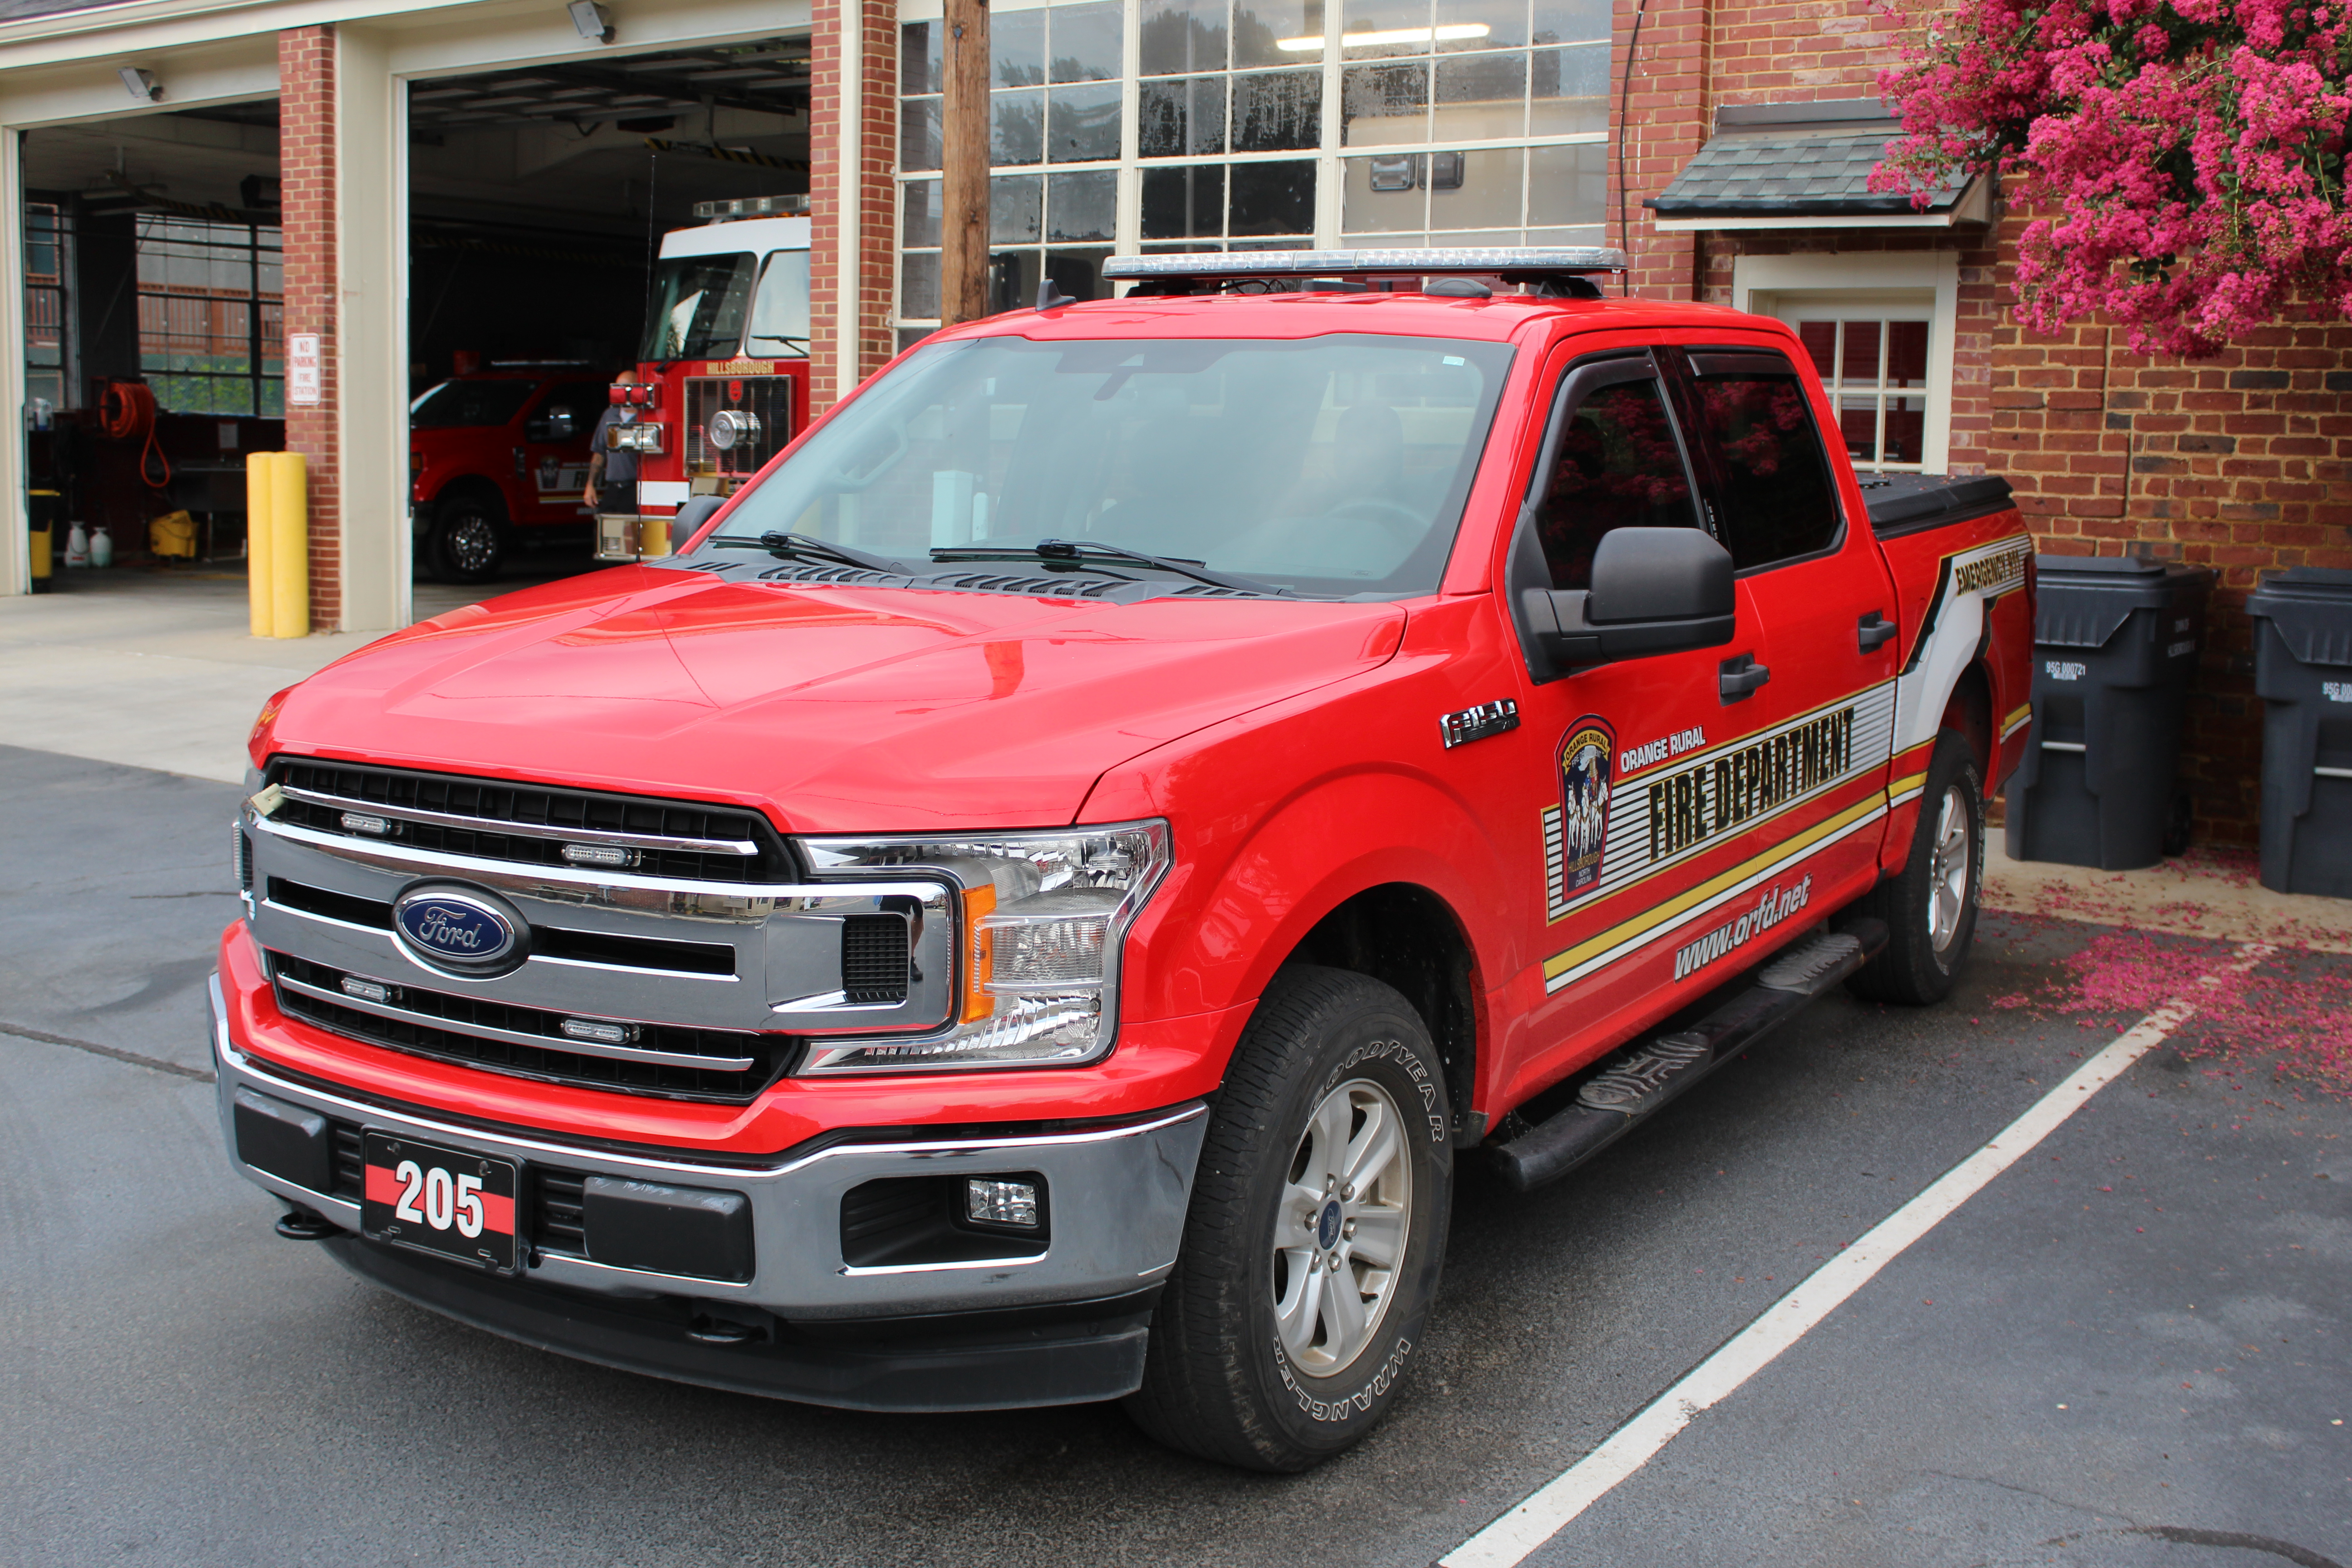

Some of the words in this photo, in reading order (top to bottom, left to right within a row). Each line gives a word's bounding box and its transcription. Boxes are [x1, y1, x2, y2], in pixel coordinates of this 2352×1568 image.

[300, 341, 310, 353] NO
[294, 356, 317, 368] PARKING
[706, 361, 774, 375] HILLSBOROUGH
[294, 386, 317, 395] STATION
[299, 373, 312, 382] FIRE
[1955, 552, 2006, 597] EMERGENCY
[2007, 548, 2021, 578] 911
[2046, 661, 2060, 673] 95G
[2062, 662, 2086, 676] 000721
[2323, 681, 2340, 695] 95G
[2341, 682, 2352, 696] 00
[1565, 734, 1588, 760] ORANGE
[1589, 733, 1607, 749] RURAL
[1579, 750, 1601, 760] DEENT
[1621, 736, 1668, 774] ORANGE
[1669, 724, 1706, 756] RURAL
[1649, 763, 1708, 862] FIRE
[1714, 706, 1855, 834] DEPARTMENT
[419, 906, 482, 948] Ford
[1675, 873, 1812, 982] www.orfd.net
[1308, 1039, 1445, 1142] GOODYEAR
[395, 1160, 485, 1239] 205
[1273, 1335, 1411, 1421] WRANGLER
